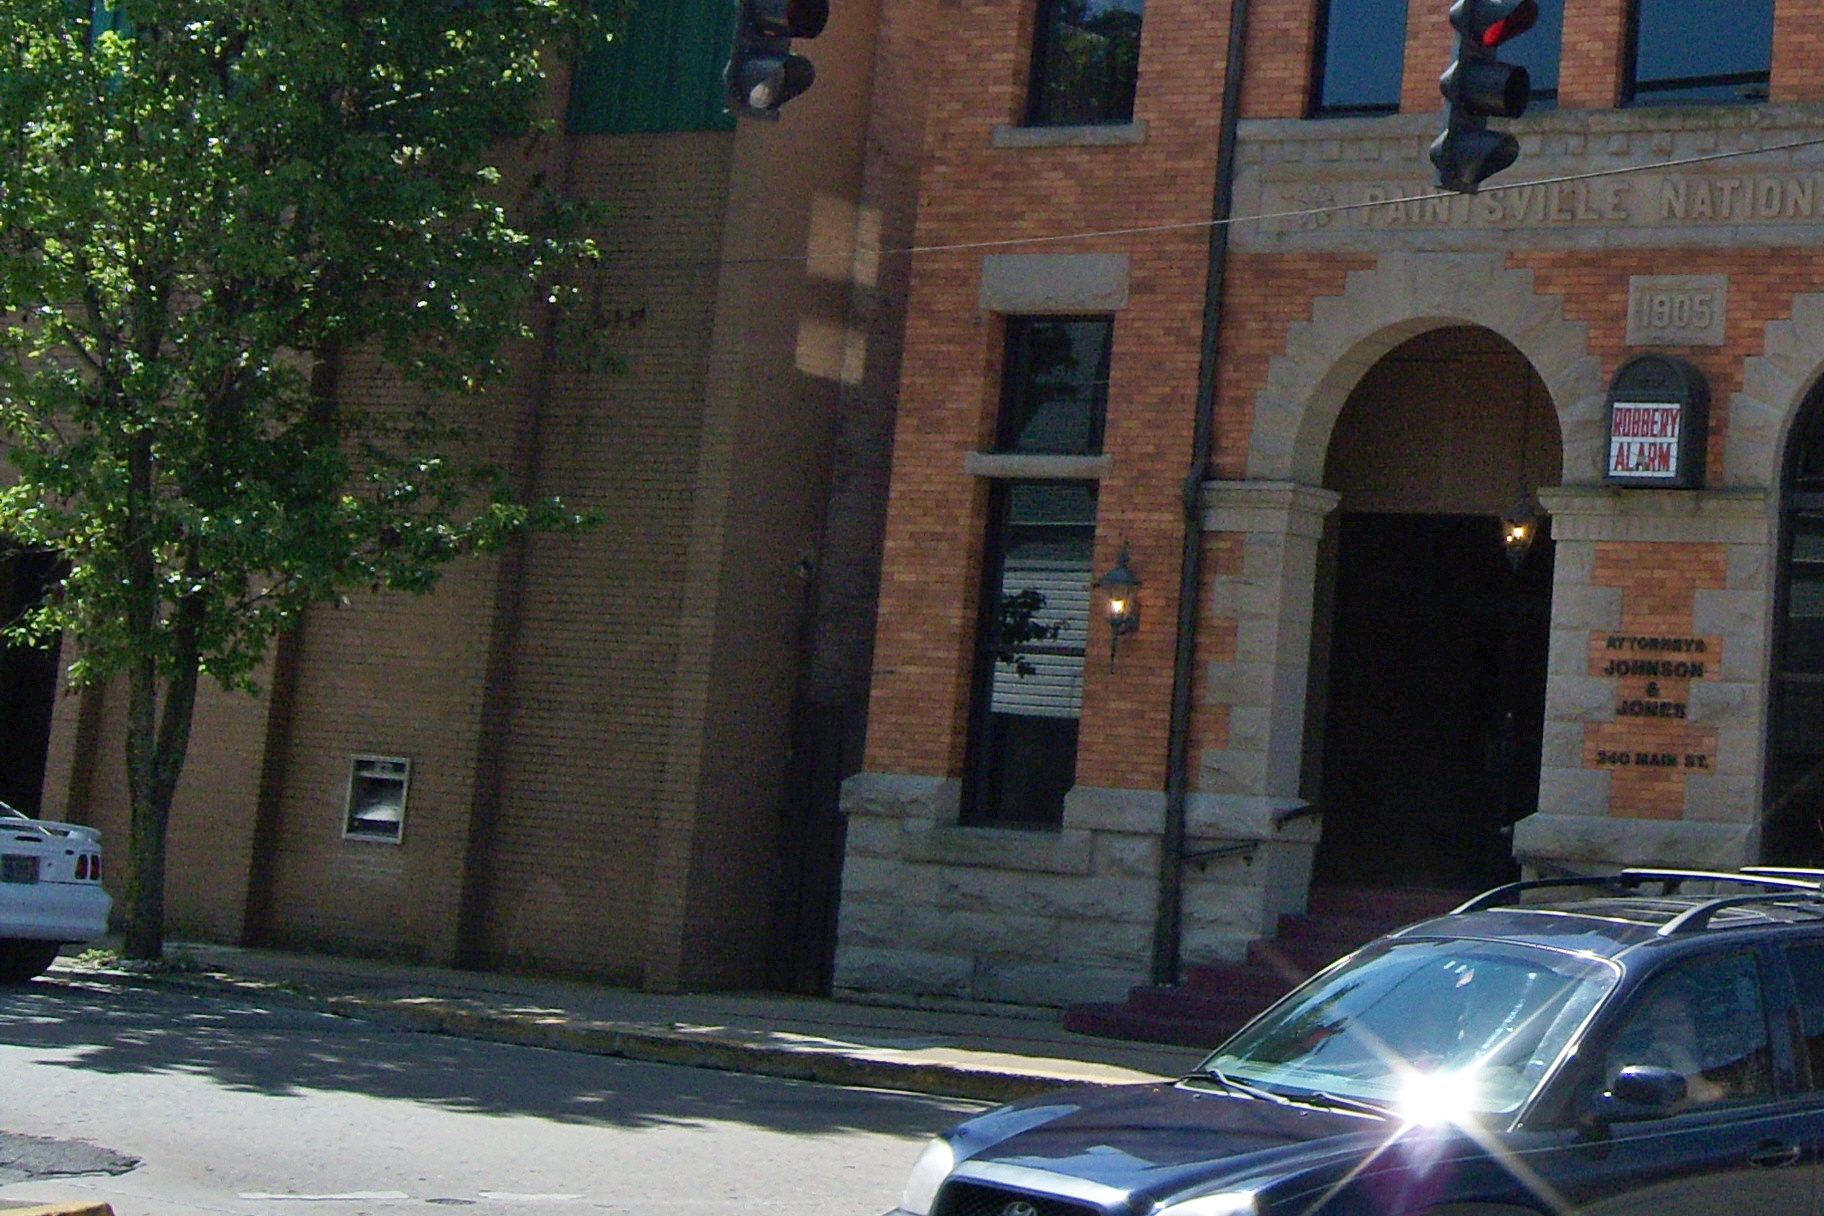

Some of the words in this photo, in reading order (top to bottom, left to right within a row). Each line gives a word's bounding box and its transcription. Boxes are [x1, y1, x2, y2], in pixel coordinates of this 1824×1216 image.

[1612, 407, 1681, 438] ROBBERY
[1613, 441, 1672, 472] ALARM
[1605, 659, 1705, 678] JOHNSON
[1646, 680, 1660, 697] &
[1616, 699, 1687, 719] JONES
[1634, 752, 1678, 767] MAIN
